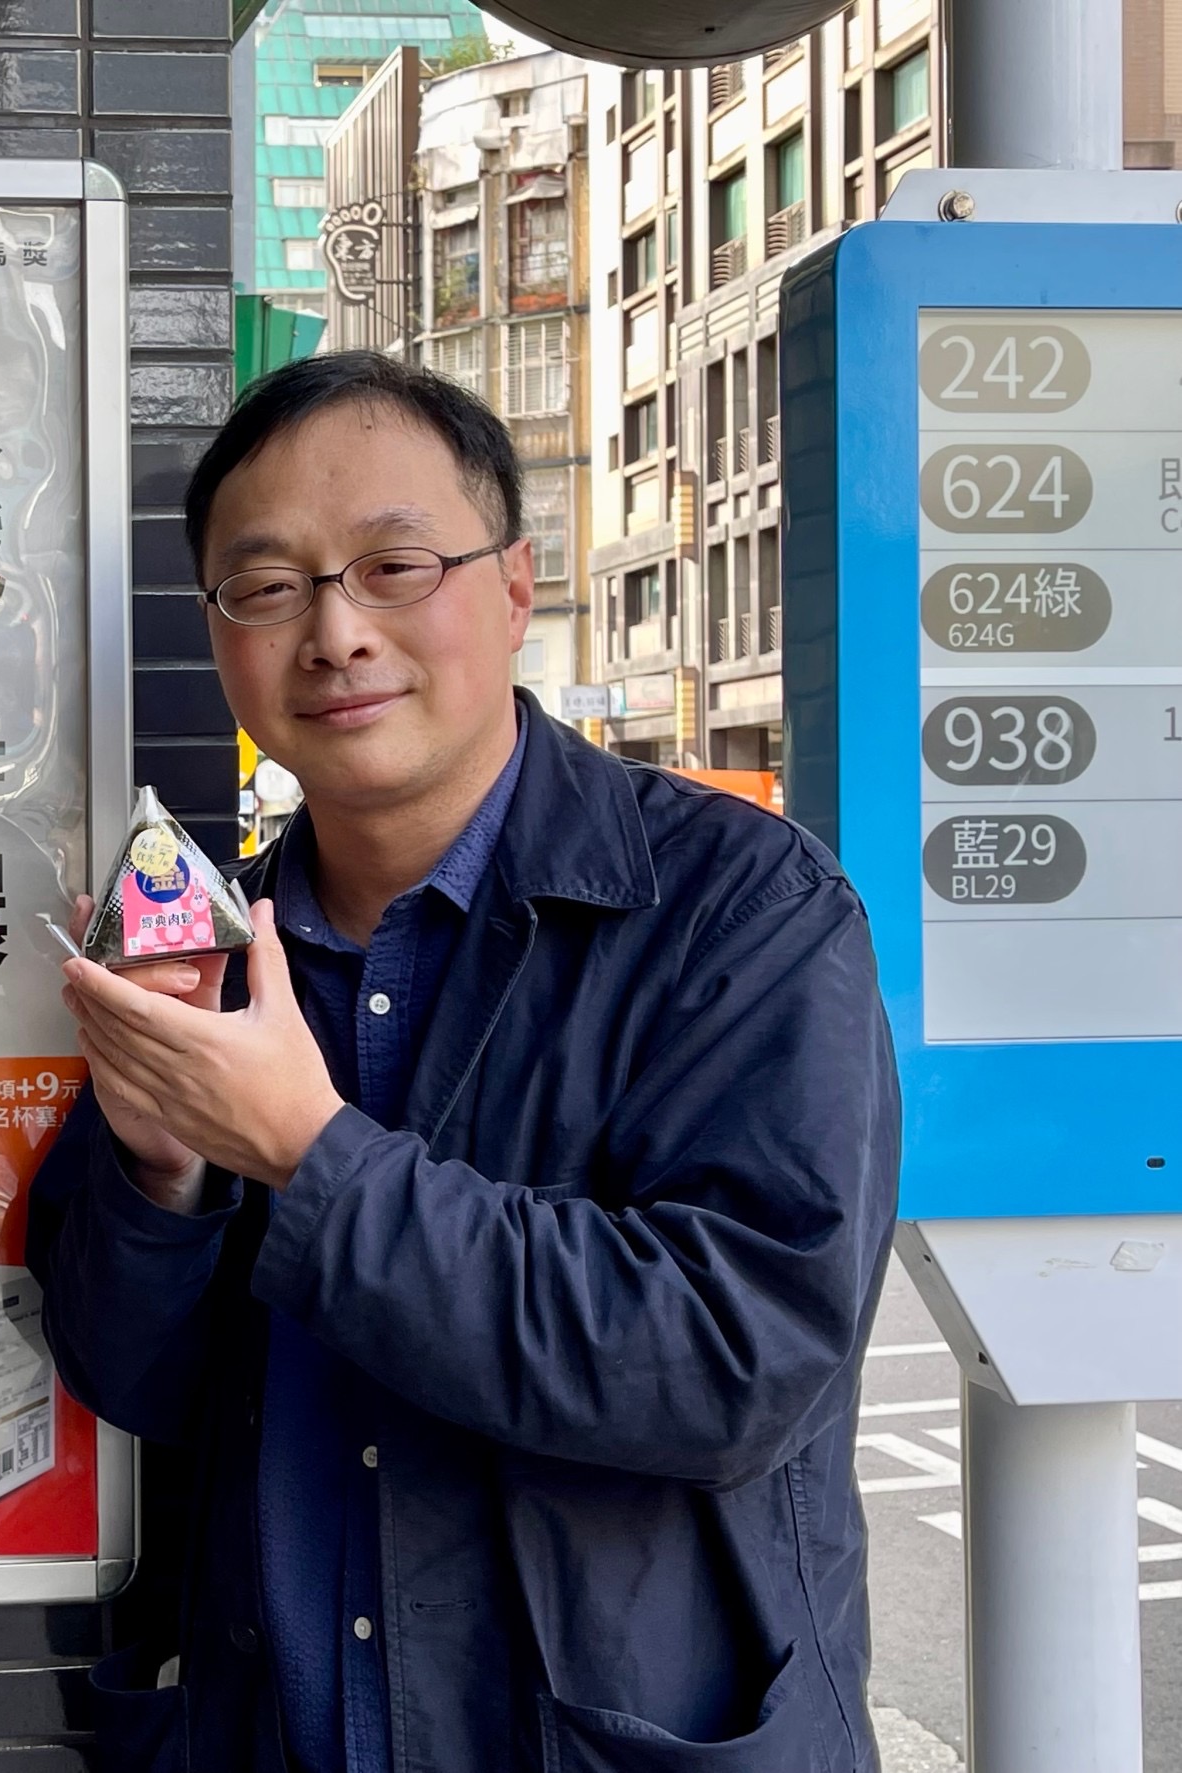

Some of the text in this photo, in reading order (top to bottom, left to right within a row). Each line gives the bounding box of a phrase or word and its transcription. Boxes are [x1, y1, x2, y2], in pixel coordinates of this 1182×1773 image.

[940, 335, 1067, 400] 242
[942, 453, 1070, 520] 624
[948, 567, 1082, 619] 624綠
[948, 622, 1015, 648] 624G
[944, 705, 1074, 772] 938
[951, 819, 1057, 870] 藍29
[951, 874, 1017, 899] BL29
